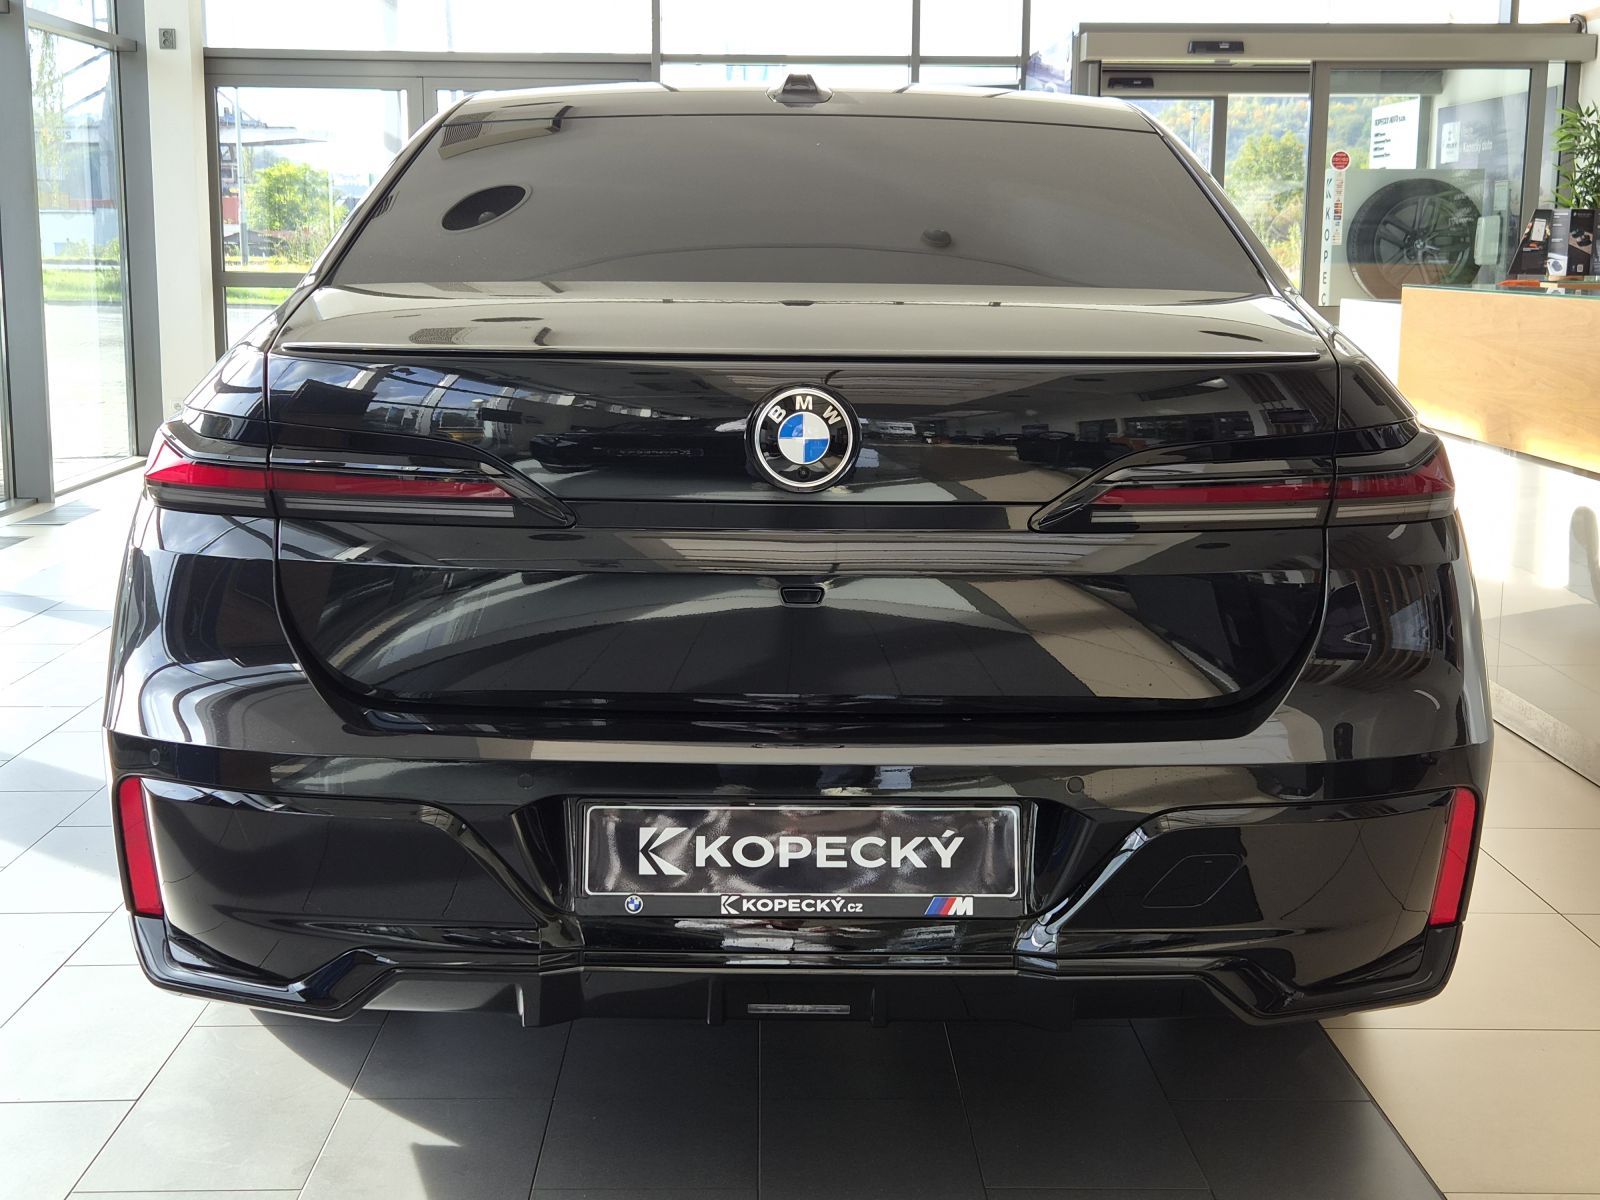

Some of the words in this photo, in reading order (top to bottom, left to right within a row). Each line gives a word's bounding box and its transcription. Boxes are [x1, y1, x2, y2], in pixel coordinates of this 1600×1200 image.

[768, 395, 842, 425] BMW
[695, 829, 965, 869] KOPECKÝ
[742, 896, 864, 913] KOPECKÝ.cz
